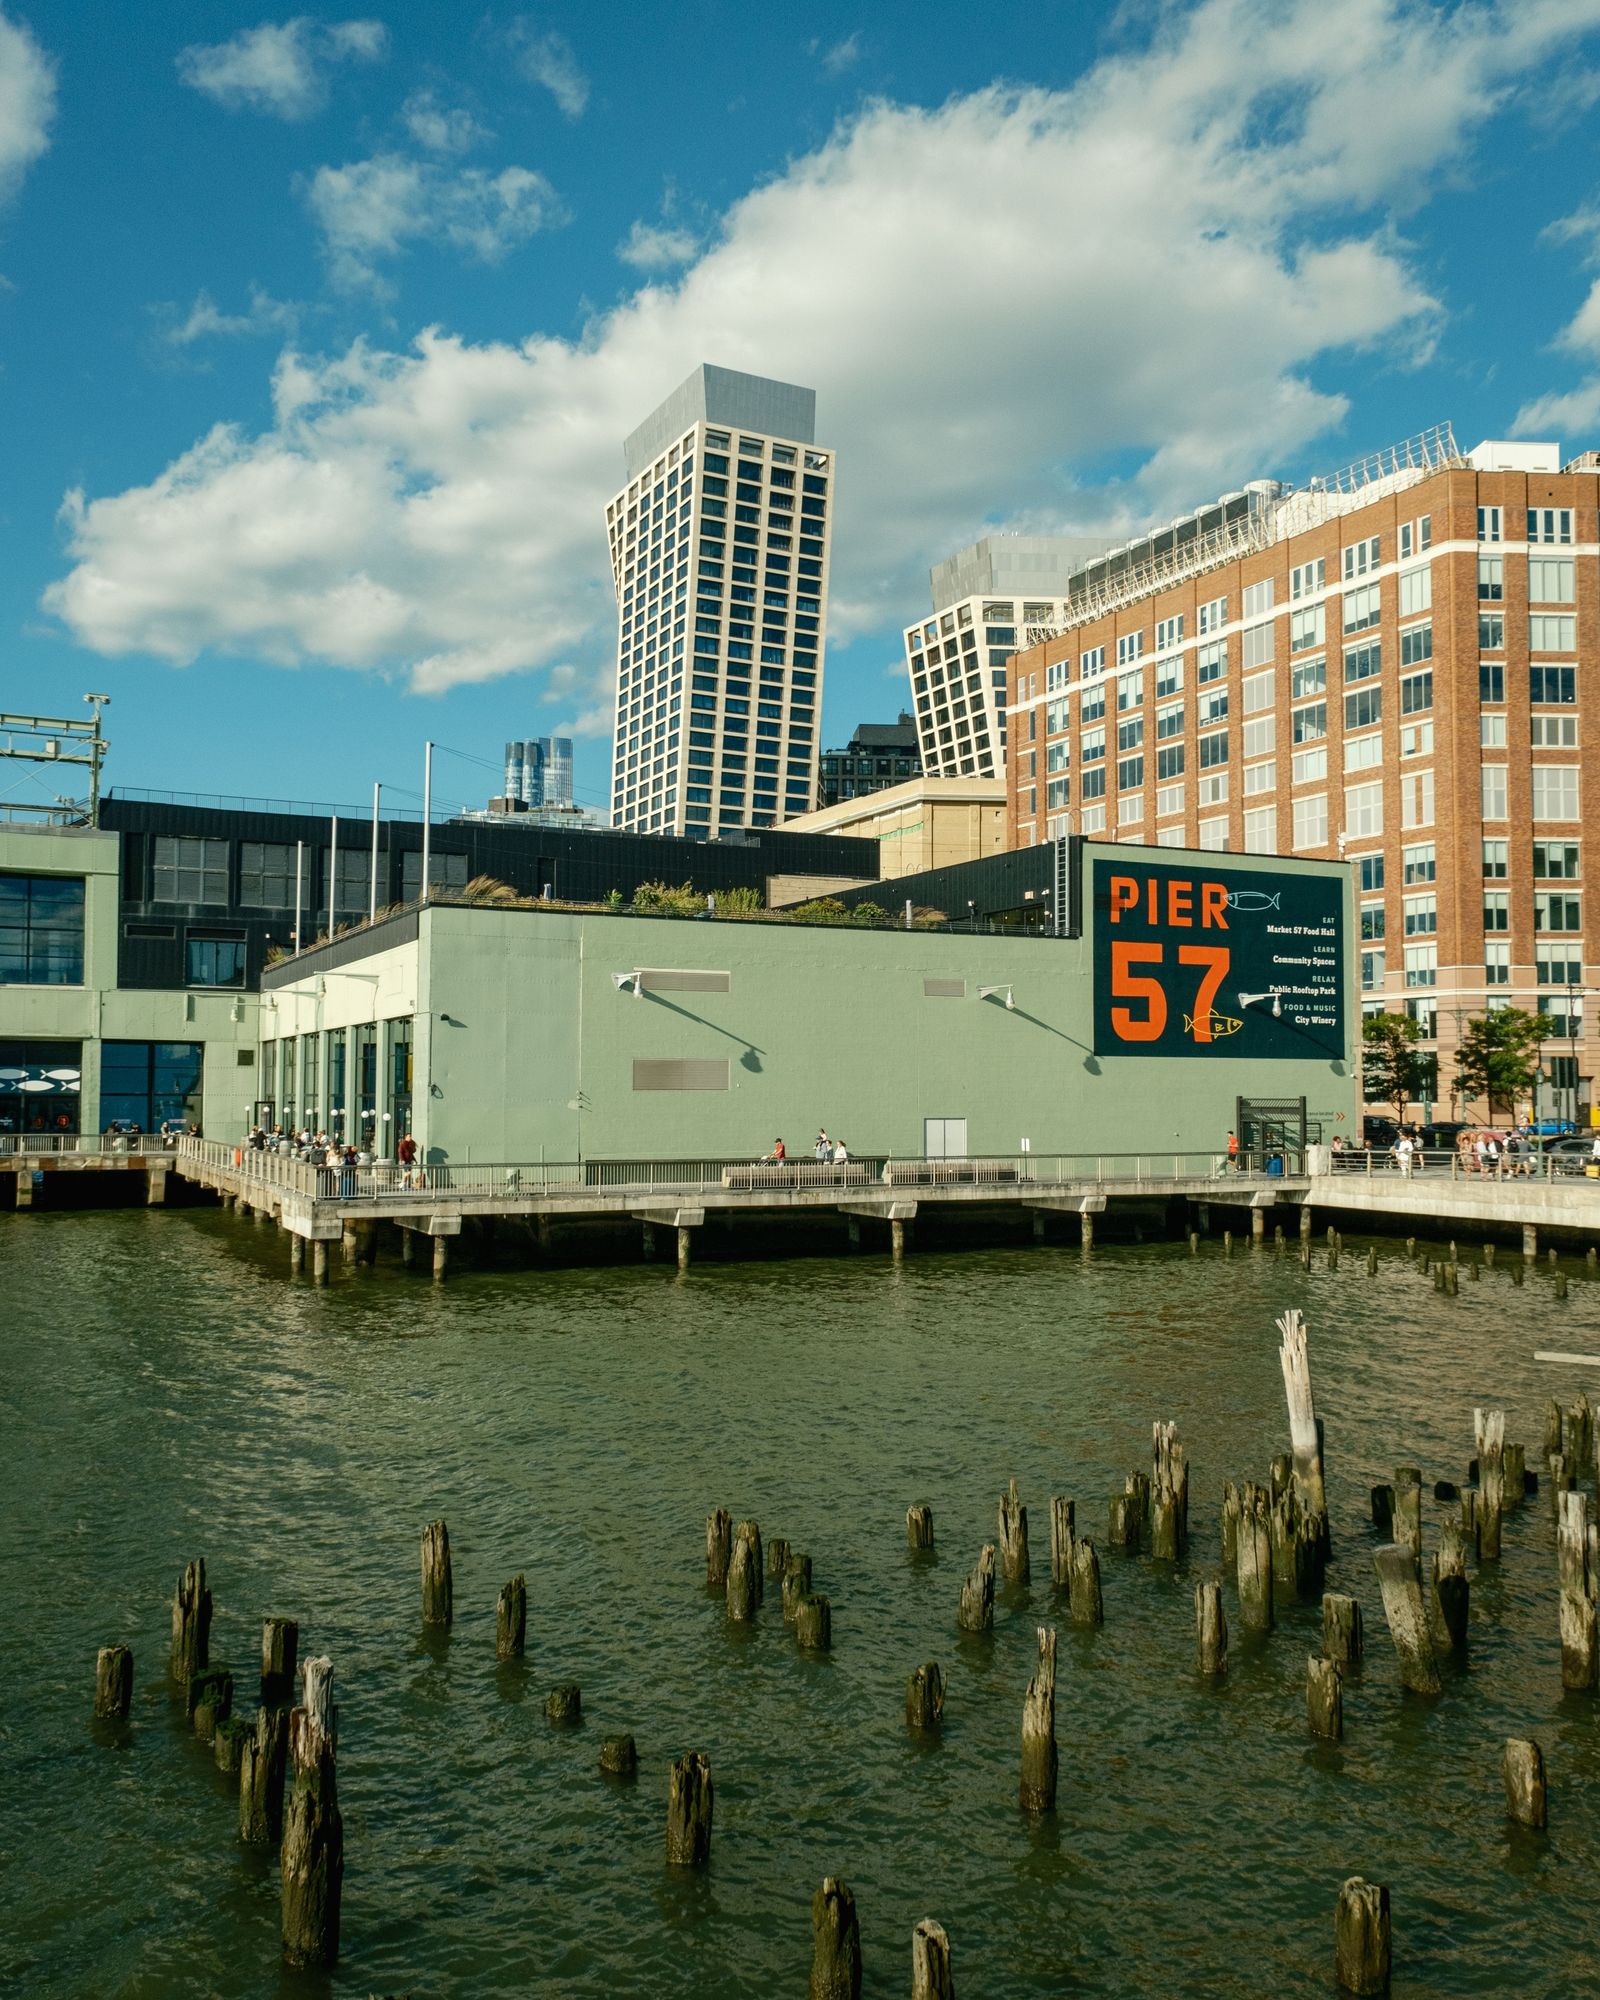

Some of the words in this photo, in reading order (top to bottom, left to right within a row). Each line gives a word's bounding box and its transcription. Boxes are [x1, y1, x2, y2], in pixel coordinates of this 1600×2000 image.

[1110, 876, 1230, 929] PIER
[1267, 925, 1292, 934] Market
[1293, 926, 1302, 934] 57
[1303, 927, 1320, 935] Food
[1321, 928, 1335, 936] Hall
[1273, 955, 1311, 967] Community
[1312, 957, 1335, 967] Spaces
[1312, 975, 1336, 983] RELAX
[1111, 941, 1230, 1042] 57
[1269, 985, 1291, 994] Public
[1292, 986, 1318, 996] Rooftop
[1319, 987, 1336, 995] Park
[1284, 1003, 1304, 1011] FOOD
[1295, 1015, 1309, 1025] City
[1310, 1016, 1336, 1026] Winery
